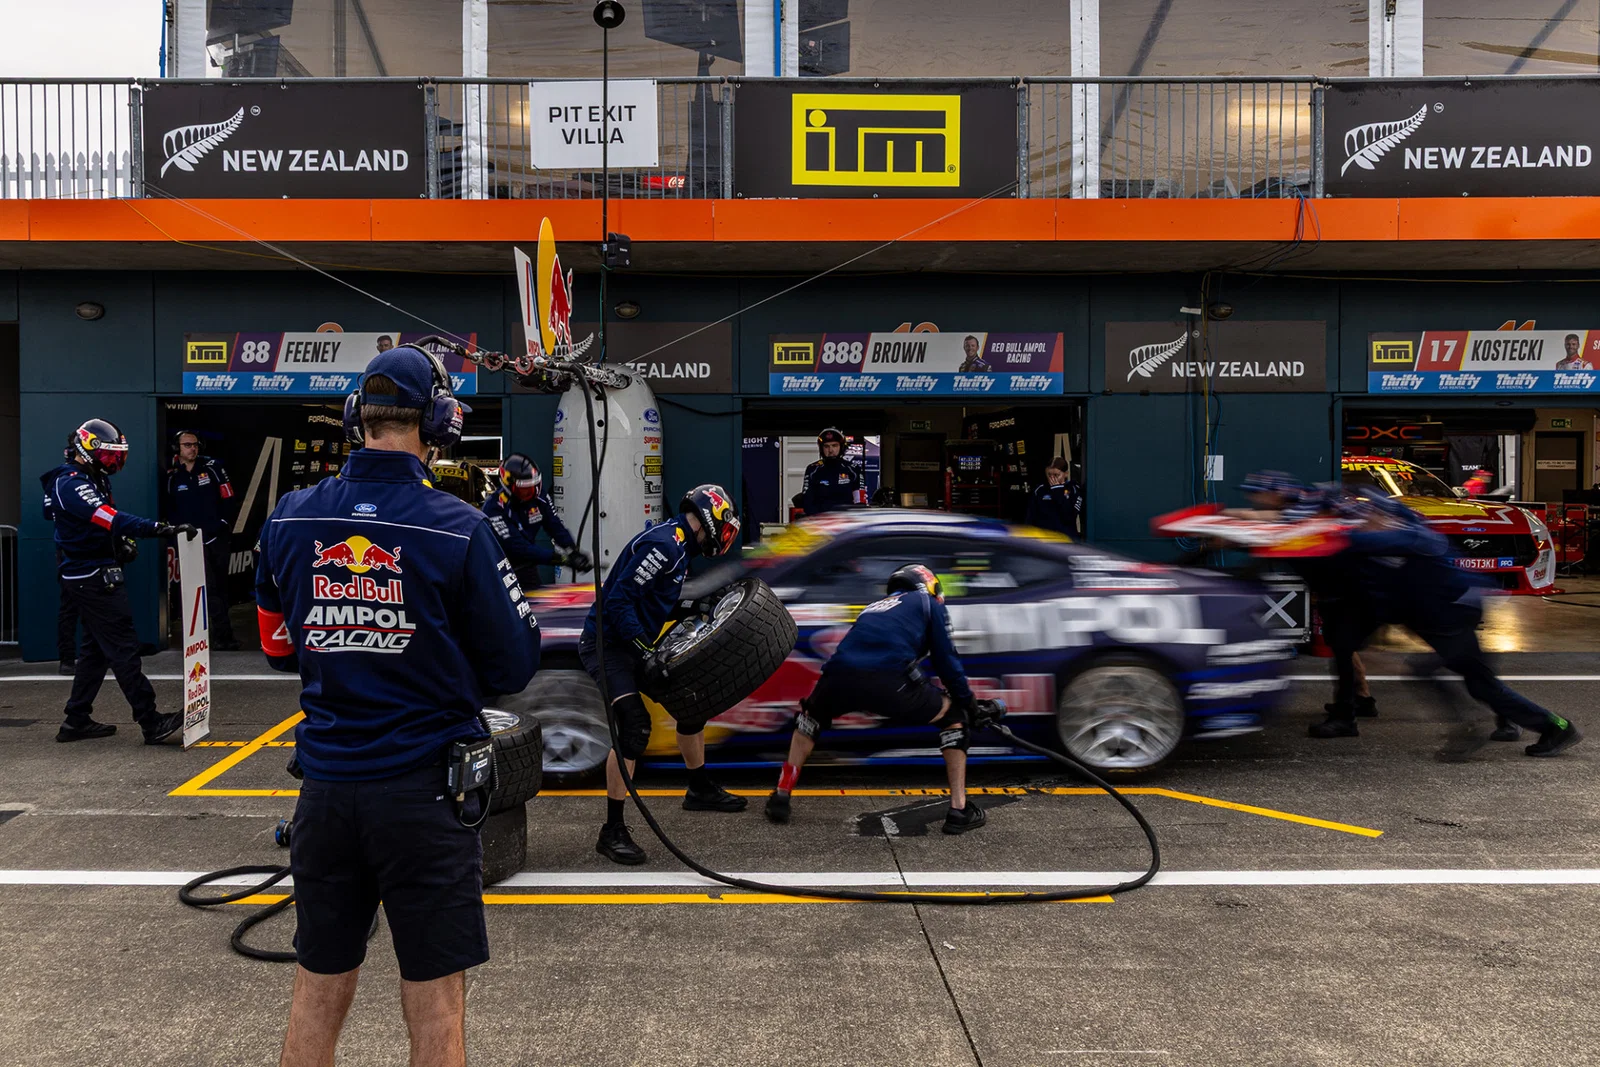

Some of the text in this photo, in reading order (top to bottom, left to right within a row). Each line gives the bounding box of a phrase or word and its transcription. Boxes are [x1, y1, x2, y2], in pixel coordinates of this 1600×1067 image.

[549, 105, 637, 123] PIT EXIT
[562, 128, 625, 145] VILLA
[223, 149, 409, 172] NEW ZEALAND
[1404, 145, 1592, 170] NEW ZEALAND
[241, 341, 271, 364] 88
[285, 341, 341, 363] FEENEY
[822, 341, 864, 364] 888
[871, 341, 928, 364] BROWN
[991, 342, 1047, 352] RED BULL AMPOL
[1430, 340, 1457, 361] 17
[1471, 339, 1544, 361] KOSTECKI
[1007, 353, 1032, 363] RACING
[1172, 361, 1305, 377] NEW ZEALAND
[195, 375, 238, 391] Thrifty
[253, 375, 295, 391] Thrifty
[310, 375, 352, 391] Thrifty
[782, 376, 824, 392] Thrifty
[839, 376, 882, 392] Thrifty
[896, 376, 939, 392] Thrifty
[953, 376, 996, 392] Thrifty
[1010, 376, 1053, 392] Thrifty
[1381, 374, 1425, 390] Thrifty
[1439, 374, 1482, 390] Thrifty
[1496, 374, 1539, 390] Thrifty
[1553, 374, 1597, 390] Thrifty
[1346, 426, 1423, 439] DXC
[76, 443, 94, 464] AMPOL
[313, 575, 404, 604] Red Bull
[304, 606, 416, 630] AMPOL
[272, 621, 292, 644] 4
[305, 630, 412, 648] RACING
[185, 640, 208, 658] AMPOL
[187, 680, 208, 702] Red Bull
[185, 696, 209, 716] AMPOL
